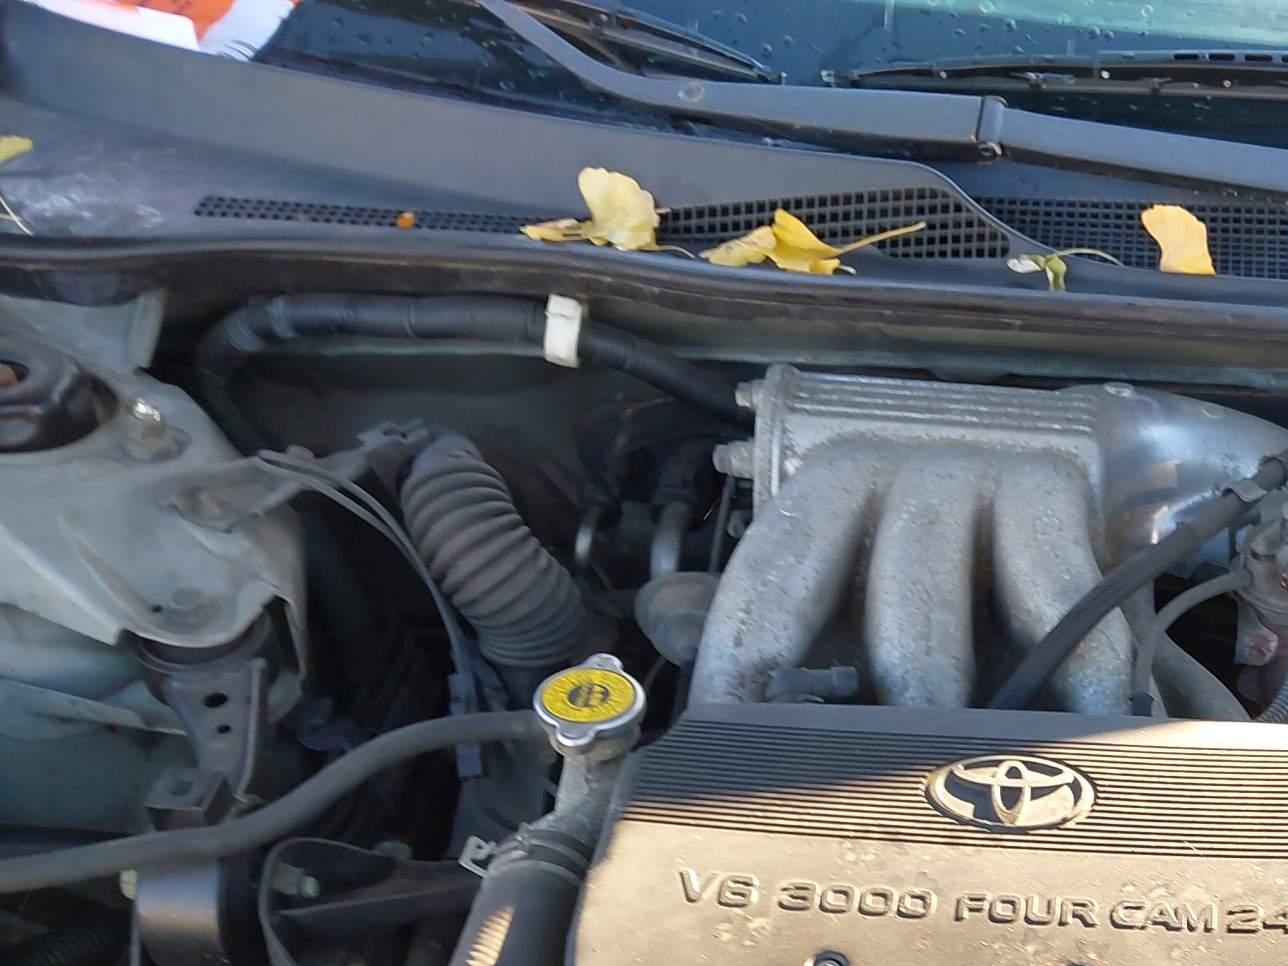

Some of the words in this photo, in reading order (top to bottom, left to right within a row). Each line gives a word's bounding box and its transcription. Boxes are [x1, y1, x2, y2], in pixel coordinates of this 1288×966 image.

[679, 867, 760, 908] V6
[777, 879, 937, 919] 3000
[954, 890, 1100, 929] FOUR
[1109, 898, 1217, 933] CAM
